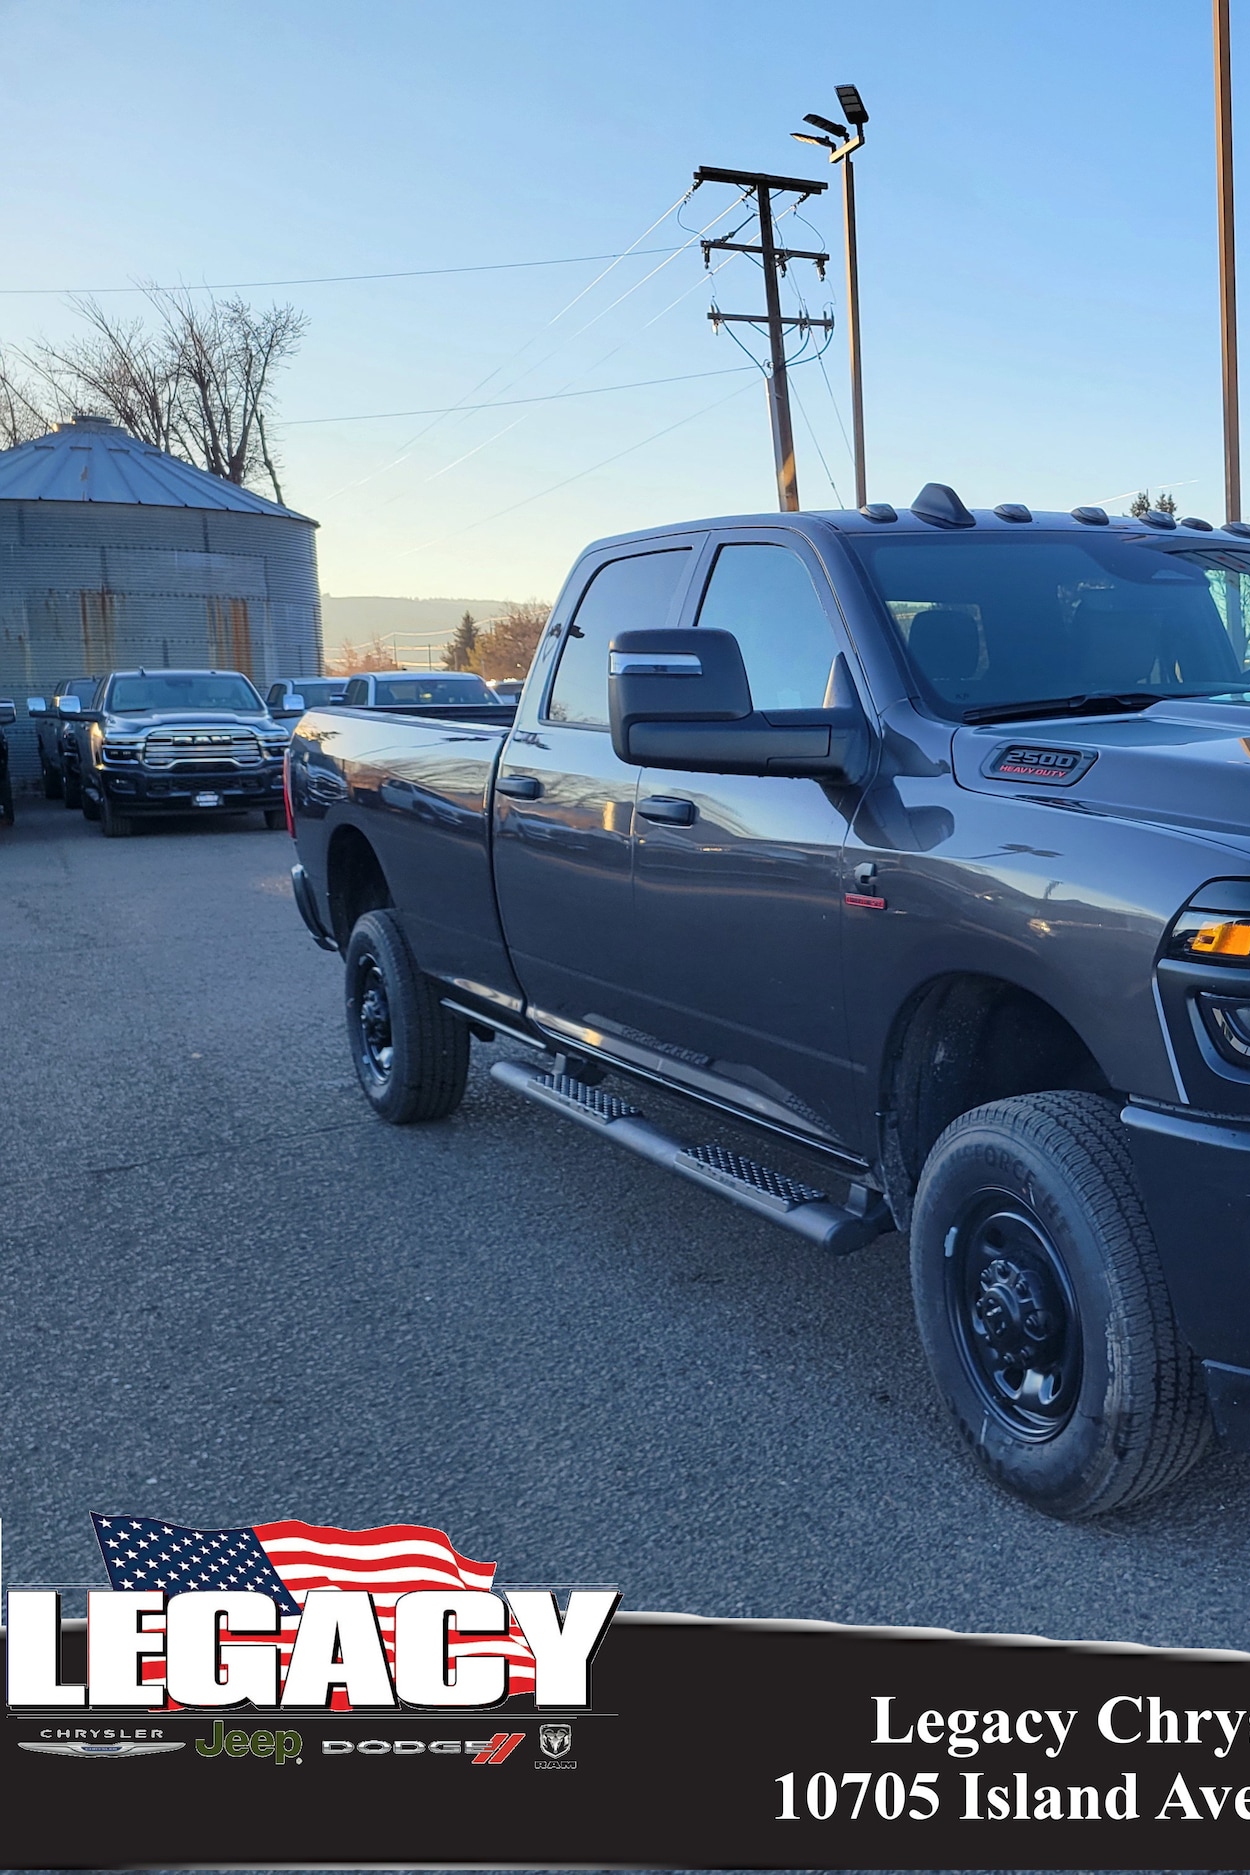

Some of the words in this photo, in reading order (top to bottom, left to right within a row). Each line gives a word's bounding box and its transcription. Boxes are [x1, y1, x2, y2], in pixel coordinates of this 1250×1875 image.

[1006, 750, 1074, 767] 2500
[1000, 764, 1035, 774] HEAVY
[1035, 768, 1066, 777] DUTY
